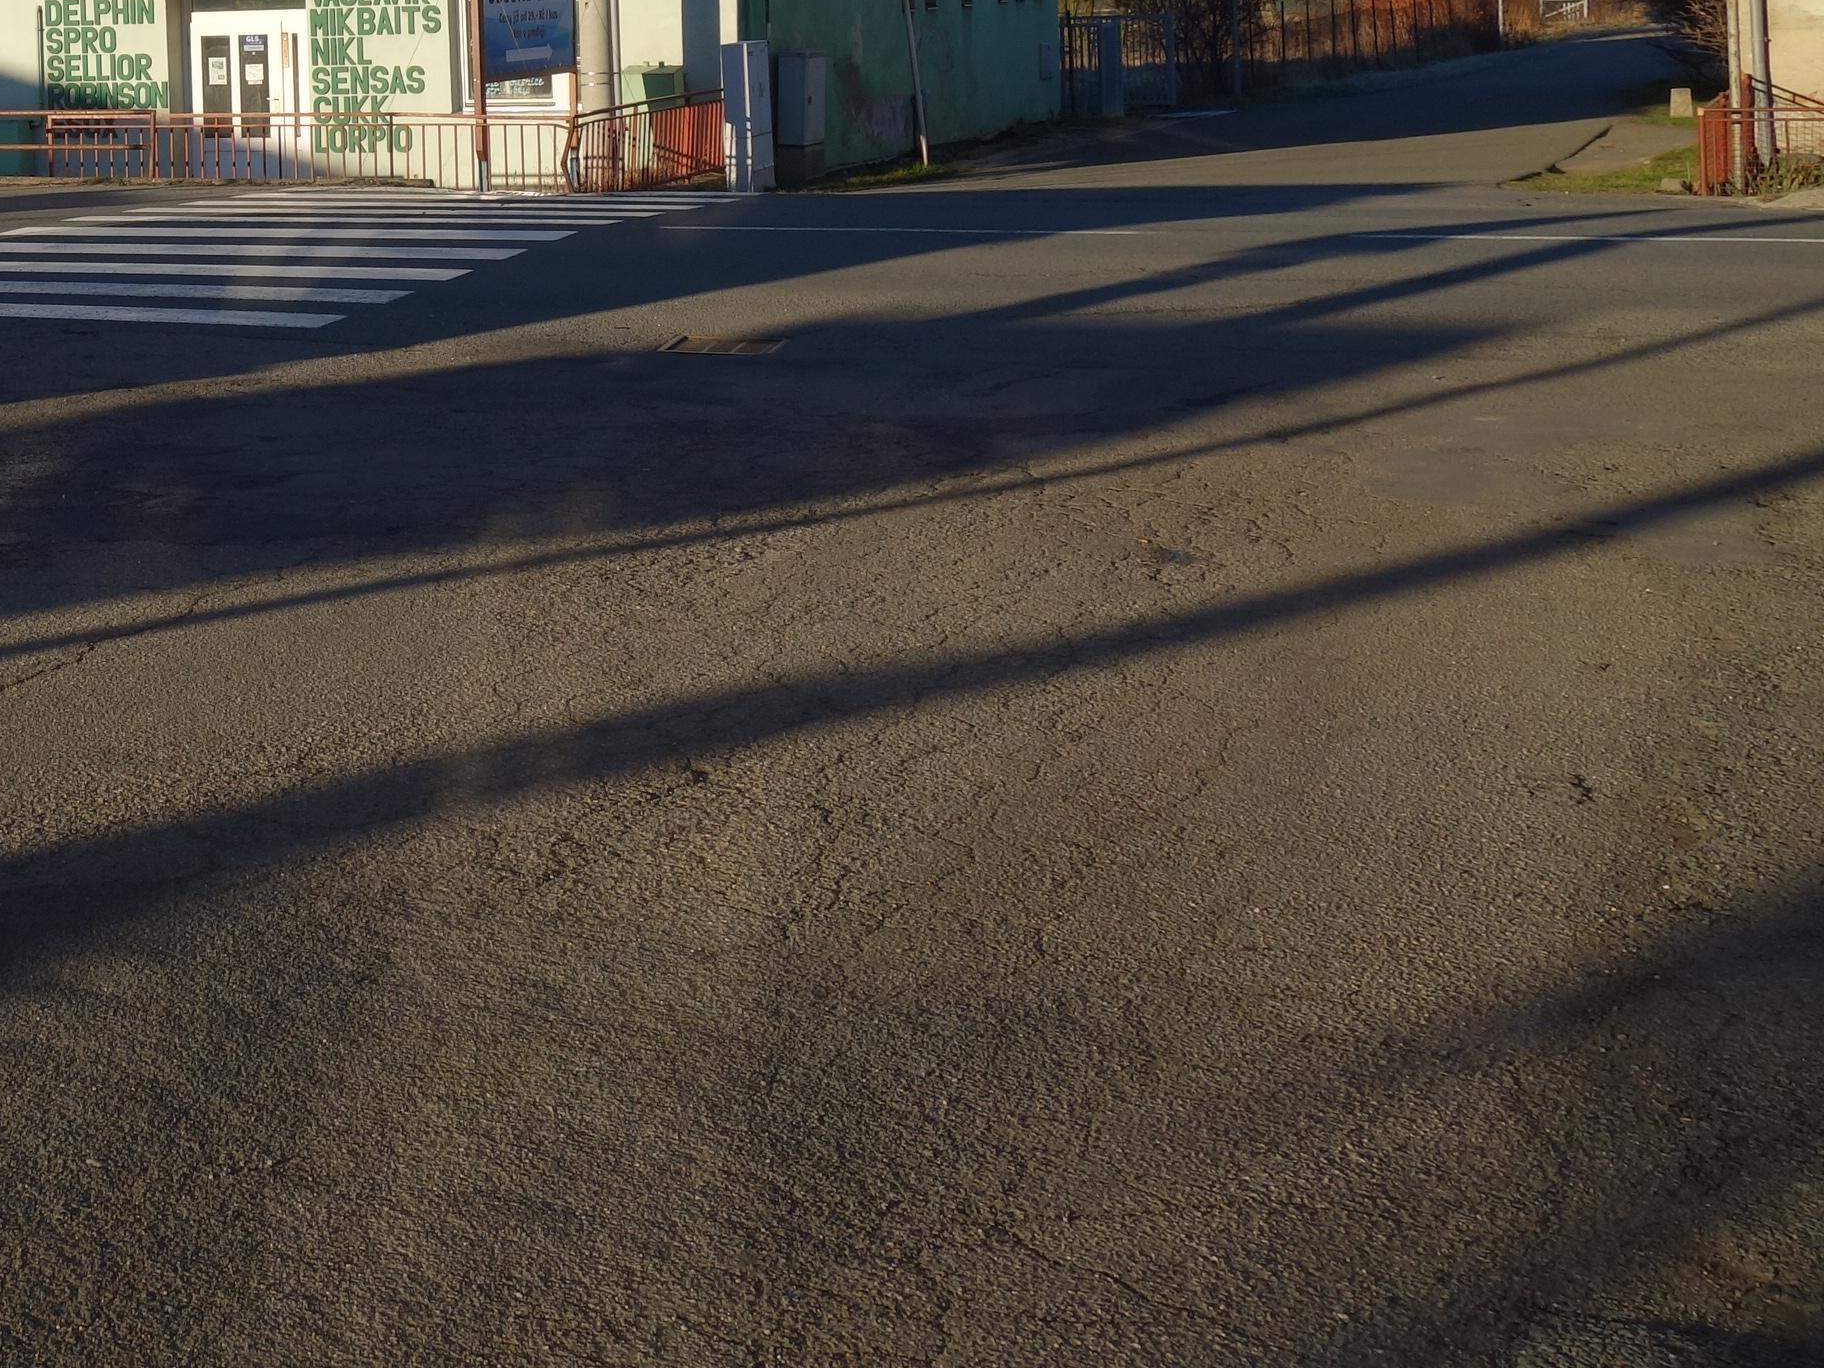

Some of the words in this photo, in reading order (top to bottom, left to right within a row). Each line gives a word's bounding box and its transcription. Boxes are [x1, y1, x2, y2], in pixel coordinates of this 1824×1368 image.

[309, 5, 442, 37] MIKBAITS
[45, 25, 117, 55] SPRO
[245, 35, 260, 43] GLS
[311, 35, 373, 67] NIKL
[46, 52, 153, 82] SELLIOR
[311, 65, 426, 95] SENSAS
[47, 81, 169, 110] ROBINSON
[313, 95, 389, 125] CUKK
[313, 125, 413, 154] LORPIO
